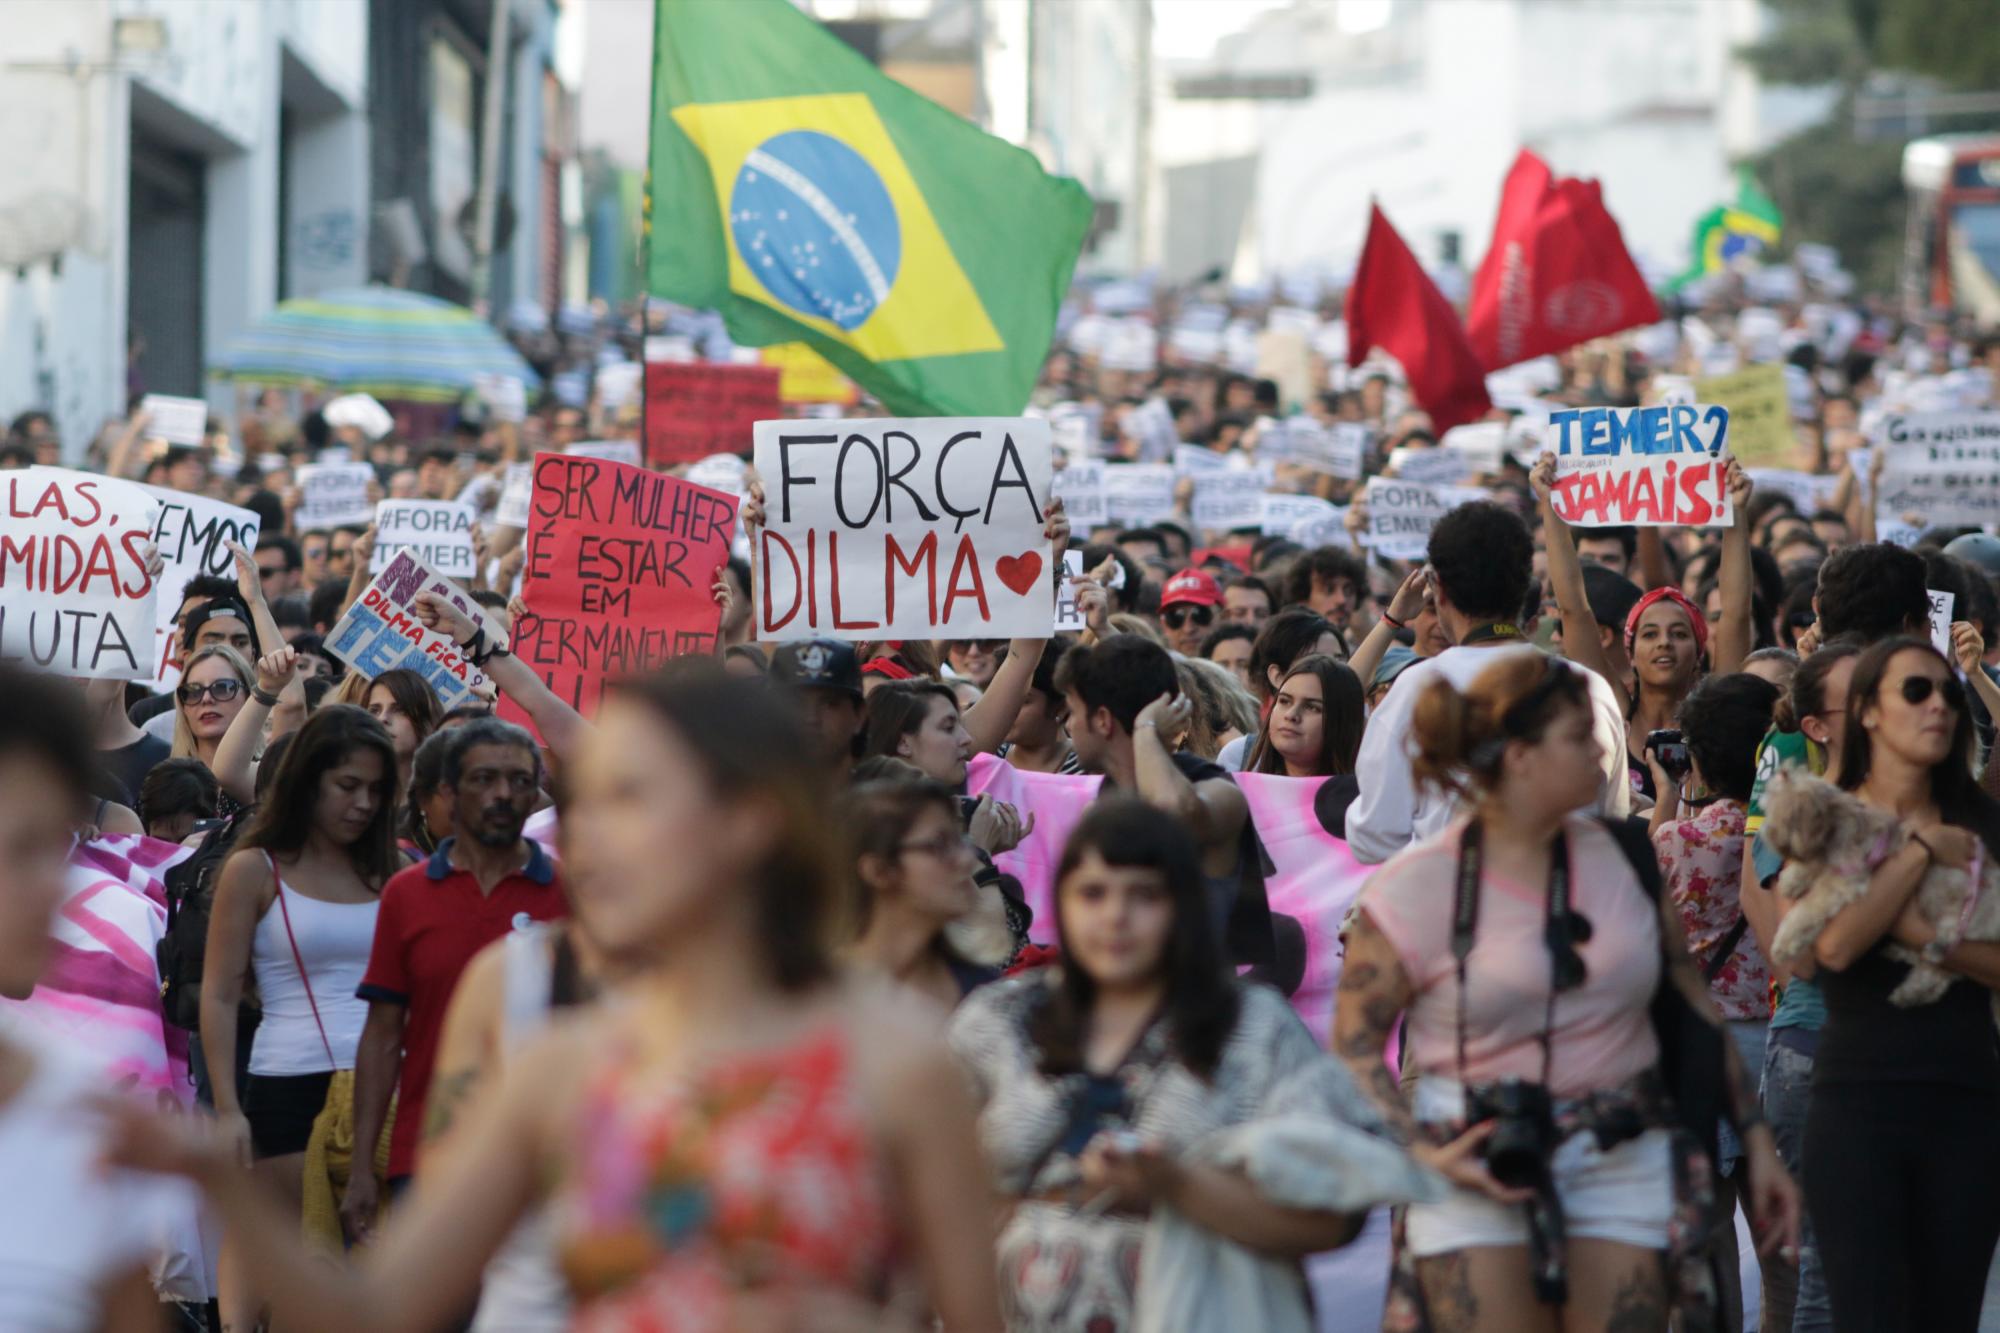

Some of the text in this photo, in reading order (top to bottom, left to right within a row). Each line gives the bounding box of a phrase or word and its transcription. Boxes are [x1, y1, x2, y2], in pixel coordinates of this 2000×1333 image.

[1549, 405, 1729, 458] TEMER?
[9, 477, 119, 527] LAS,
[535, 458, 734, 552] SER MULHER
[779, 431, 1044, 533] FORÇA
[379, 508, 471, 532] #FORA
[531, 519, 693, 588] É ESTAR
[0, 532, 153, 600] MIDAS
[762, 528, 991, 633] DILMA
[581, 584, 631, 617] EM
